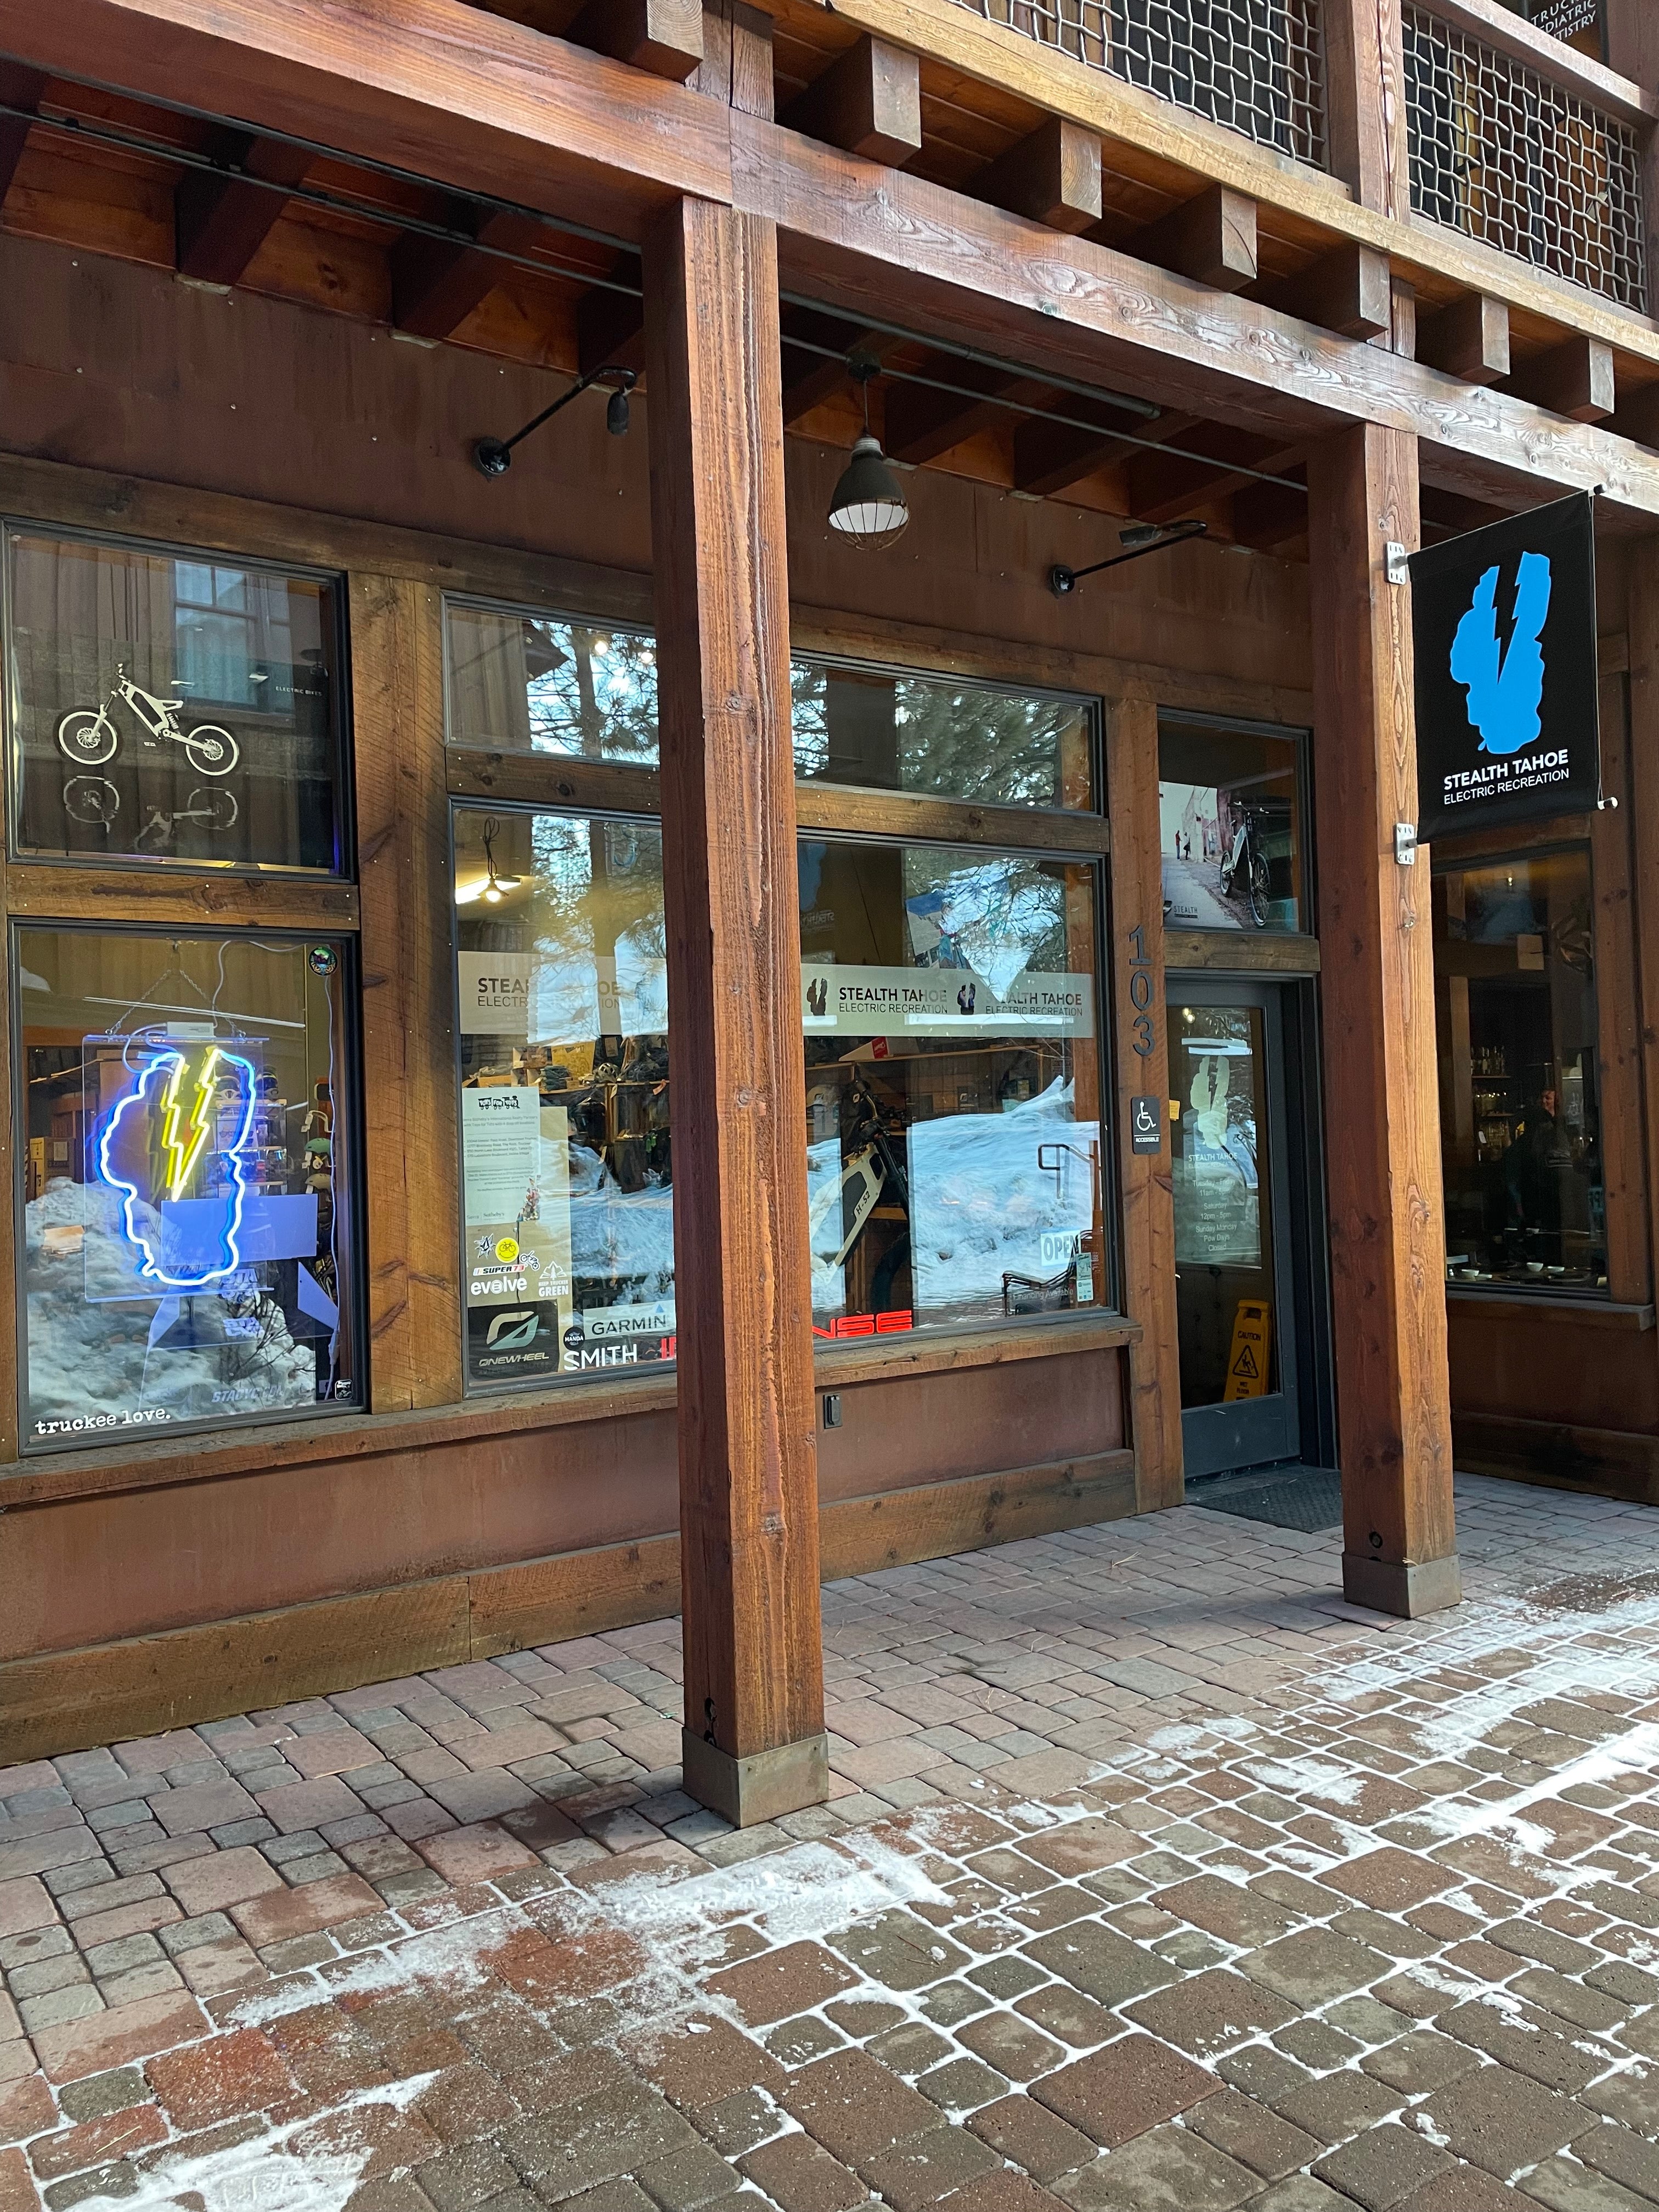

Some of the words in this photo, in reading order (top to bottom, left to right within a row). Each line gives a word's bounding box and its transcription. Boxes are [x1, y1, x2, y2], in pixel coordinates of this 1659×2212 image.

[1444, 763, 1508, 790] STEALTH
[1512, 749, 1568, 774] TAHOE
[1444, 785, 1495, 805] ELECTRIC
[1497, 768, 1569, 793] RECREATION
[1173, 905, 1198, 913] STEALTH
[839, 987, 898, 1002] STEALTH
[901, 989, 947, 1003] TAHOE
[1041, 993, 1082, 1006] TAHOE
[839, 1003, 886, 1013] ELECTRIC
[889, 1003, 947, 1014] RECREATION
[986, 1006, 1028, 1015] ELECTRIC
[1030, 1007, 1083, 1017] RECREATION
[1188, 1154, 1215, 1162] STEALTH
[1216, 1152, 1238, 1160] TAHOE
[1201, 1212, 1215, 1221] 12pm
[1220, 1211, 1231, 1220] 5pm
[1195, 1225, 1215, 1233] Sunday
[1216, 1233, 1230, 1242] Days
[1043, 1235, 1079, 1261] OPEN
[1208, 1243, 1227, 1251] Closed
[470, 1276, 527, 1295] evolve
[538, 1285, 569, 1297] GREEN
[1013, 1291, 1045, 1301] Financing
[591, 1315, 666, 1335] GARMIN
[1238, 1330, 1261, 1341] CAUTION
[478, 1352, 549, 1367] ONEWHEEL
[563, 1344, 637, 1371] SMITH
[35, 1414, 117, 1435] truckee
[121, 1408, 171, 1425] love.
